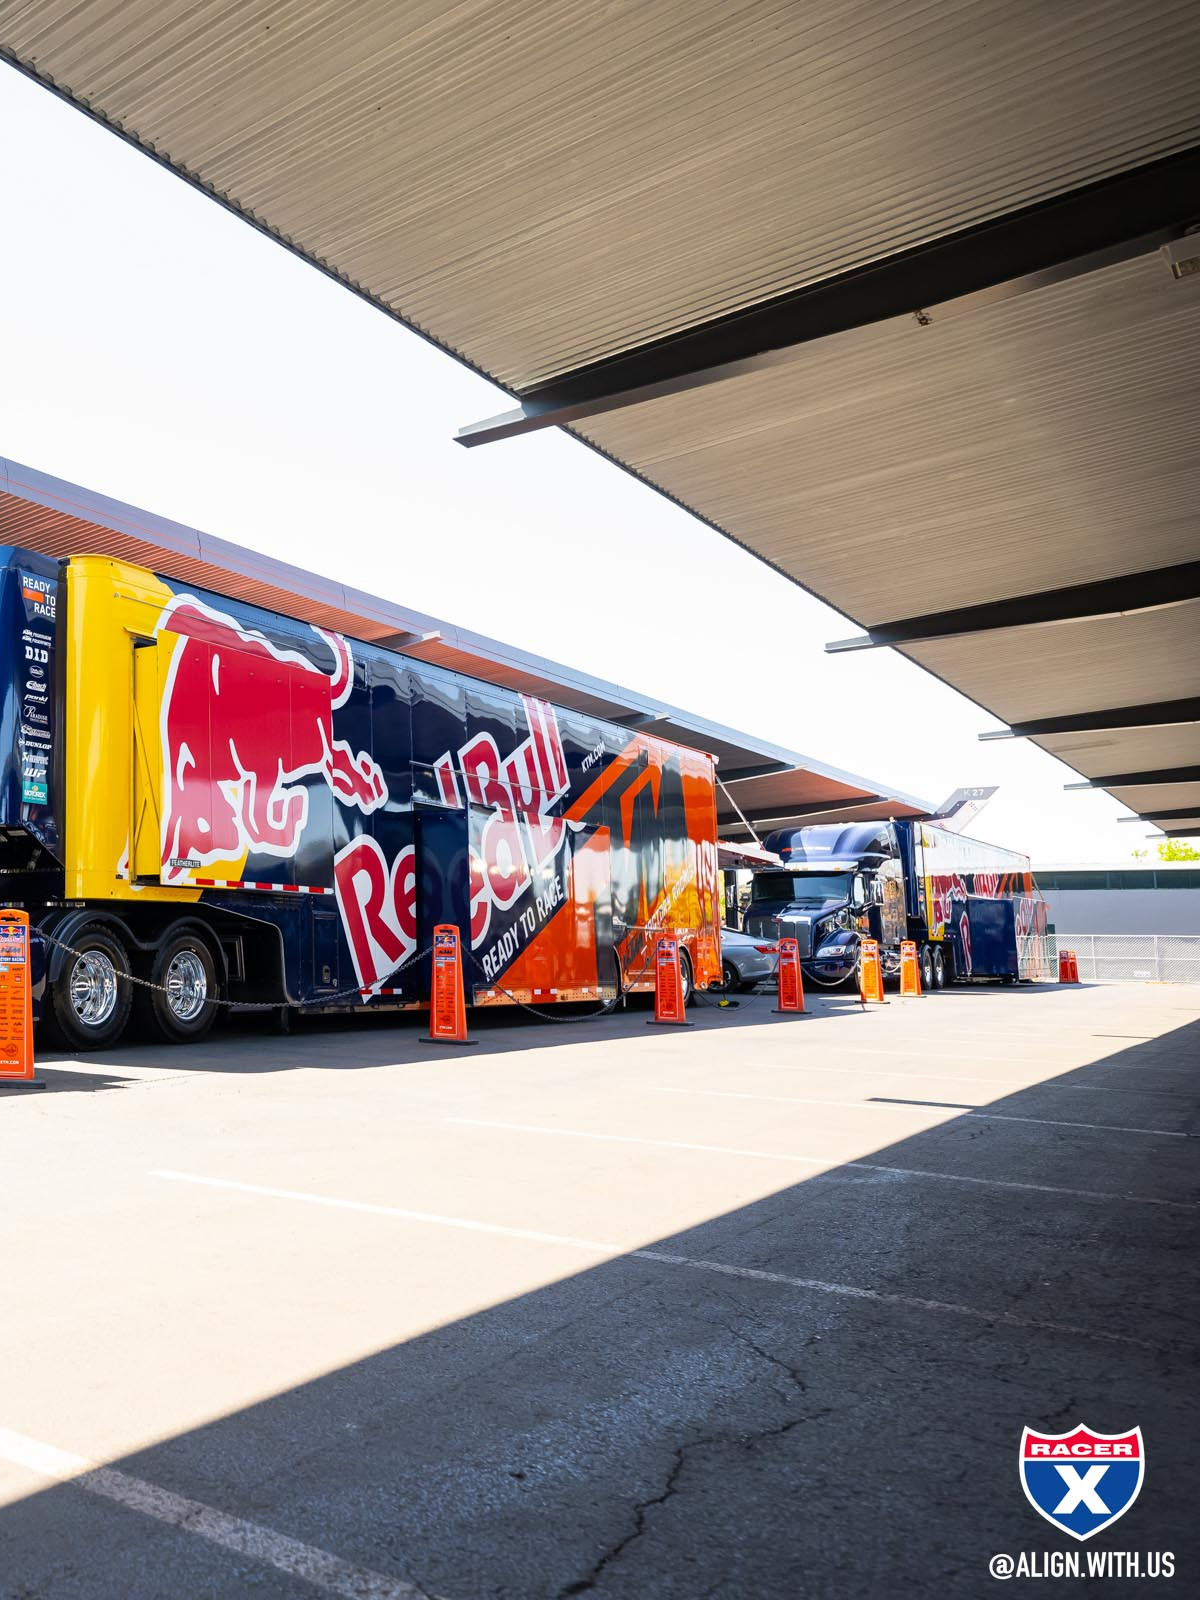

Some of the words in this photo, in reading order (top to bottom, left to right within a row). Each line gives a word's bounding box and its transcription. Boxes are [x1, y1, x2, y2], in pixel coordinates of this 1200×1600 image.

[23, 576, 50, 593] READY
[45, 594, 56, 606] TO
[34, 602, 56, 618] RACE
[25, 740, 52, 750] DUNLOP
[581, 740, 607, 774] KTM.COM
[481, 927, 521, 983] READY
[519, 908, 537, 935] TO
[536, 874, 565, 923] RACE
